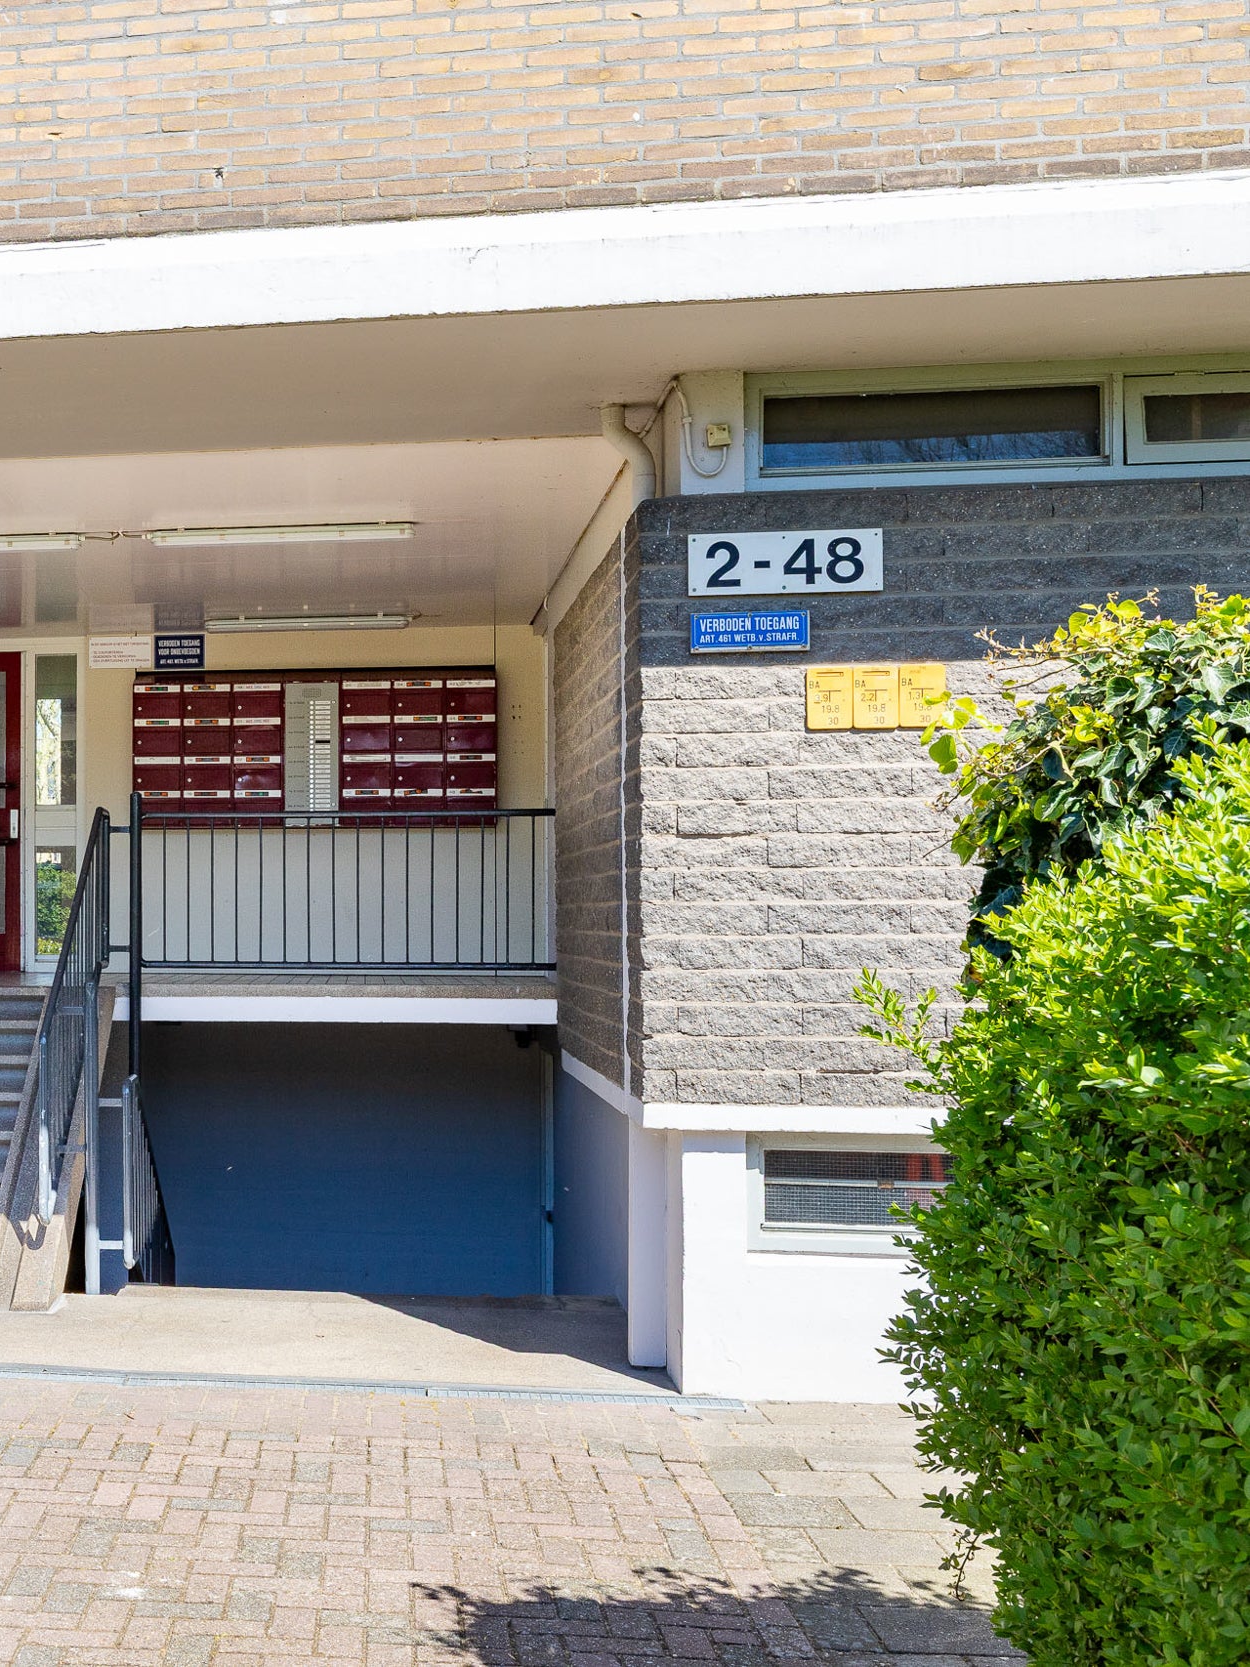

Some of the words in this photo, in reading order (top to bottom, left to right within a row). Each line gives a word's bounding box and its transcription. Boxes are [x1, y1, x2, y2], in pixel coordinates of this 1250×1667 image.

[700, 617, 752, 632] VERBODEN
[754, 616, 800, 631] TOEGANG
[158, 640, 180, 648] VERBODEN
[181, 639, 201, 647] TOEGANG
